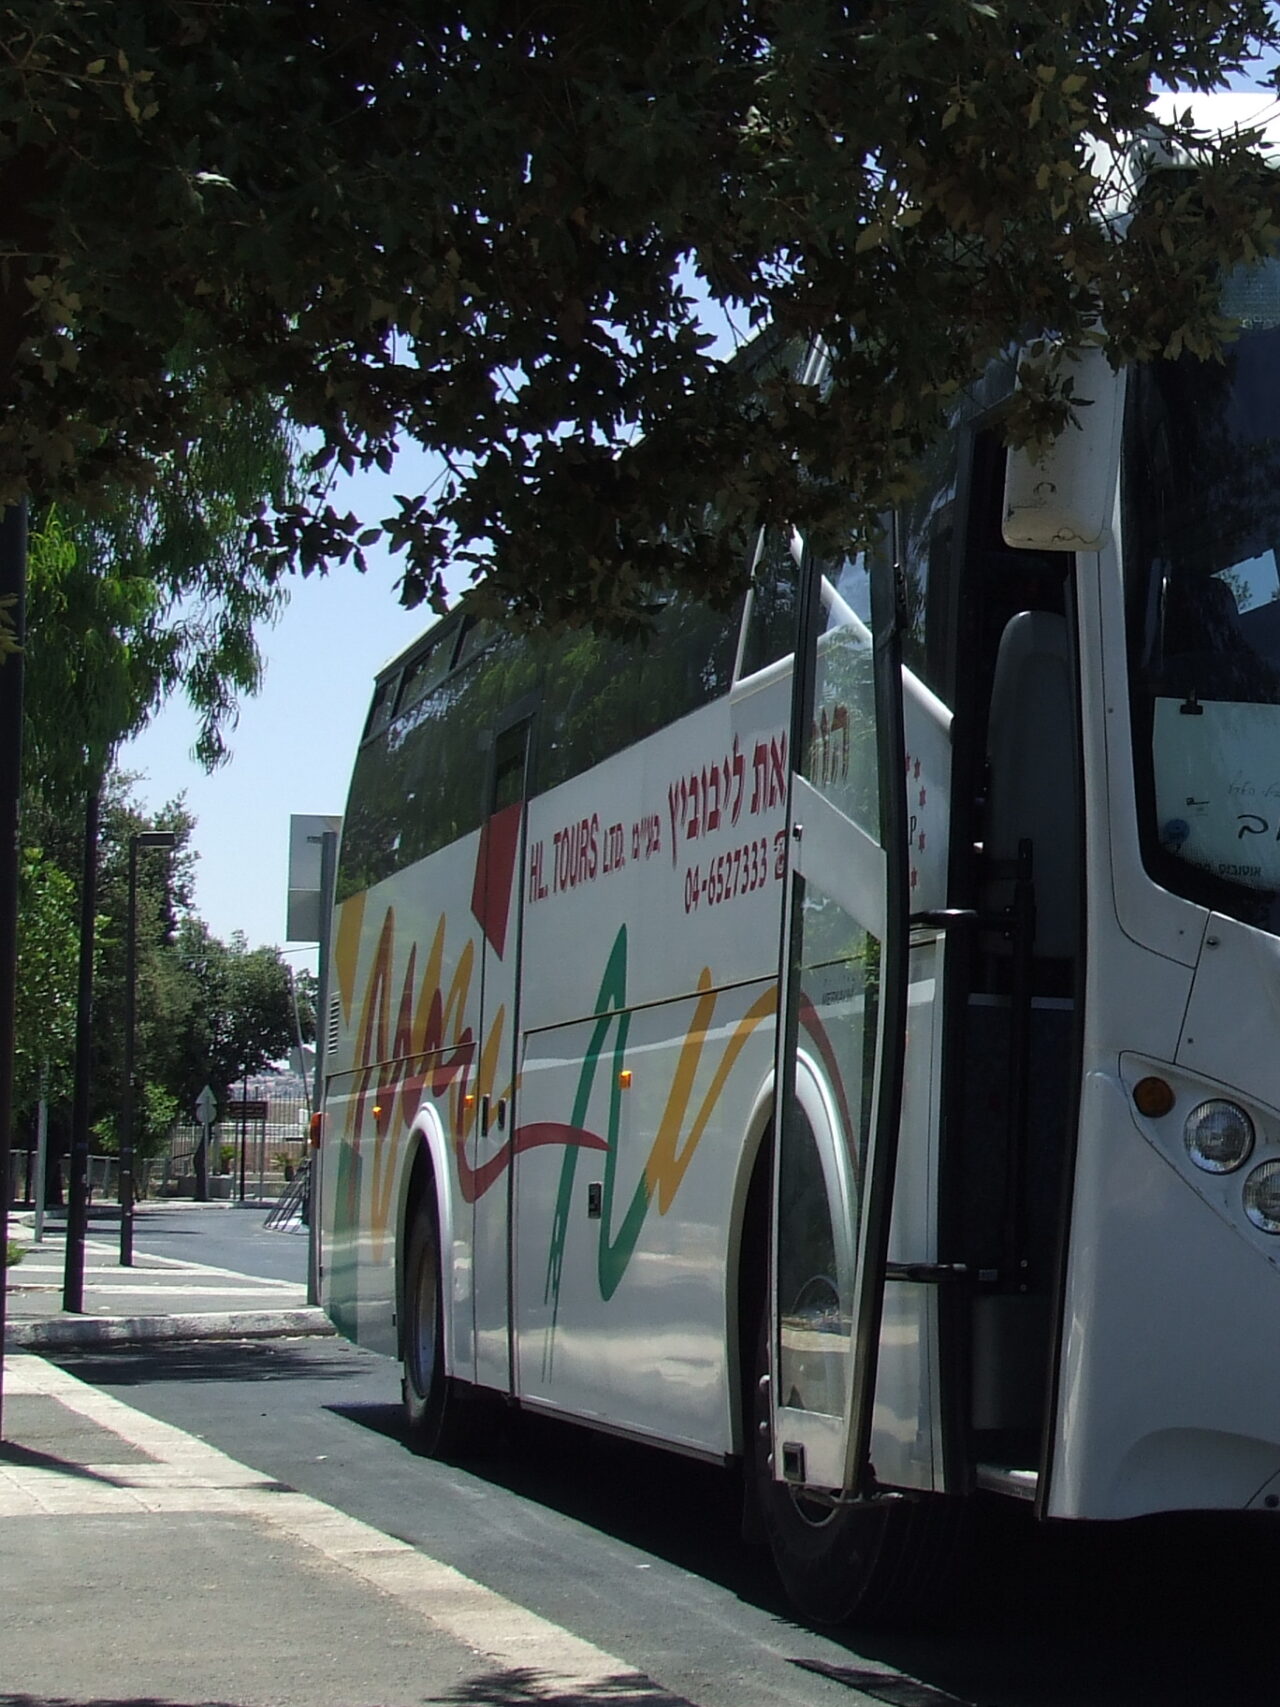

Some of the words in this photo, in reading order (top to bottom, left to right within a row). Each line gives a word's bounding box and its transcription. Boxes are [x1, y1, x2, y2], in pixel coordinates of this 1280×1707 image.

[668, 731, 745, 870] ליבוביץ
[750, 728, 787, 816] את
[552, 812, 599, 894] TOURS
[684, 837, 768, 914] 04-6527333
[1218, 862, 1262, 877] אוטובוס
